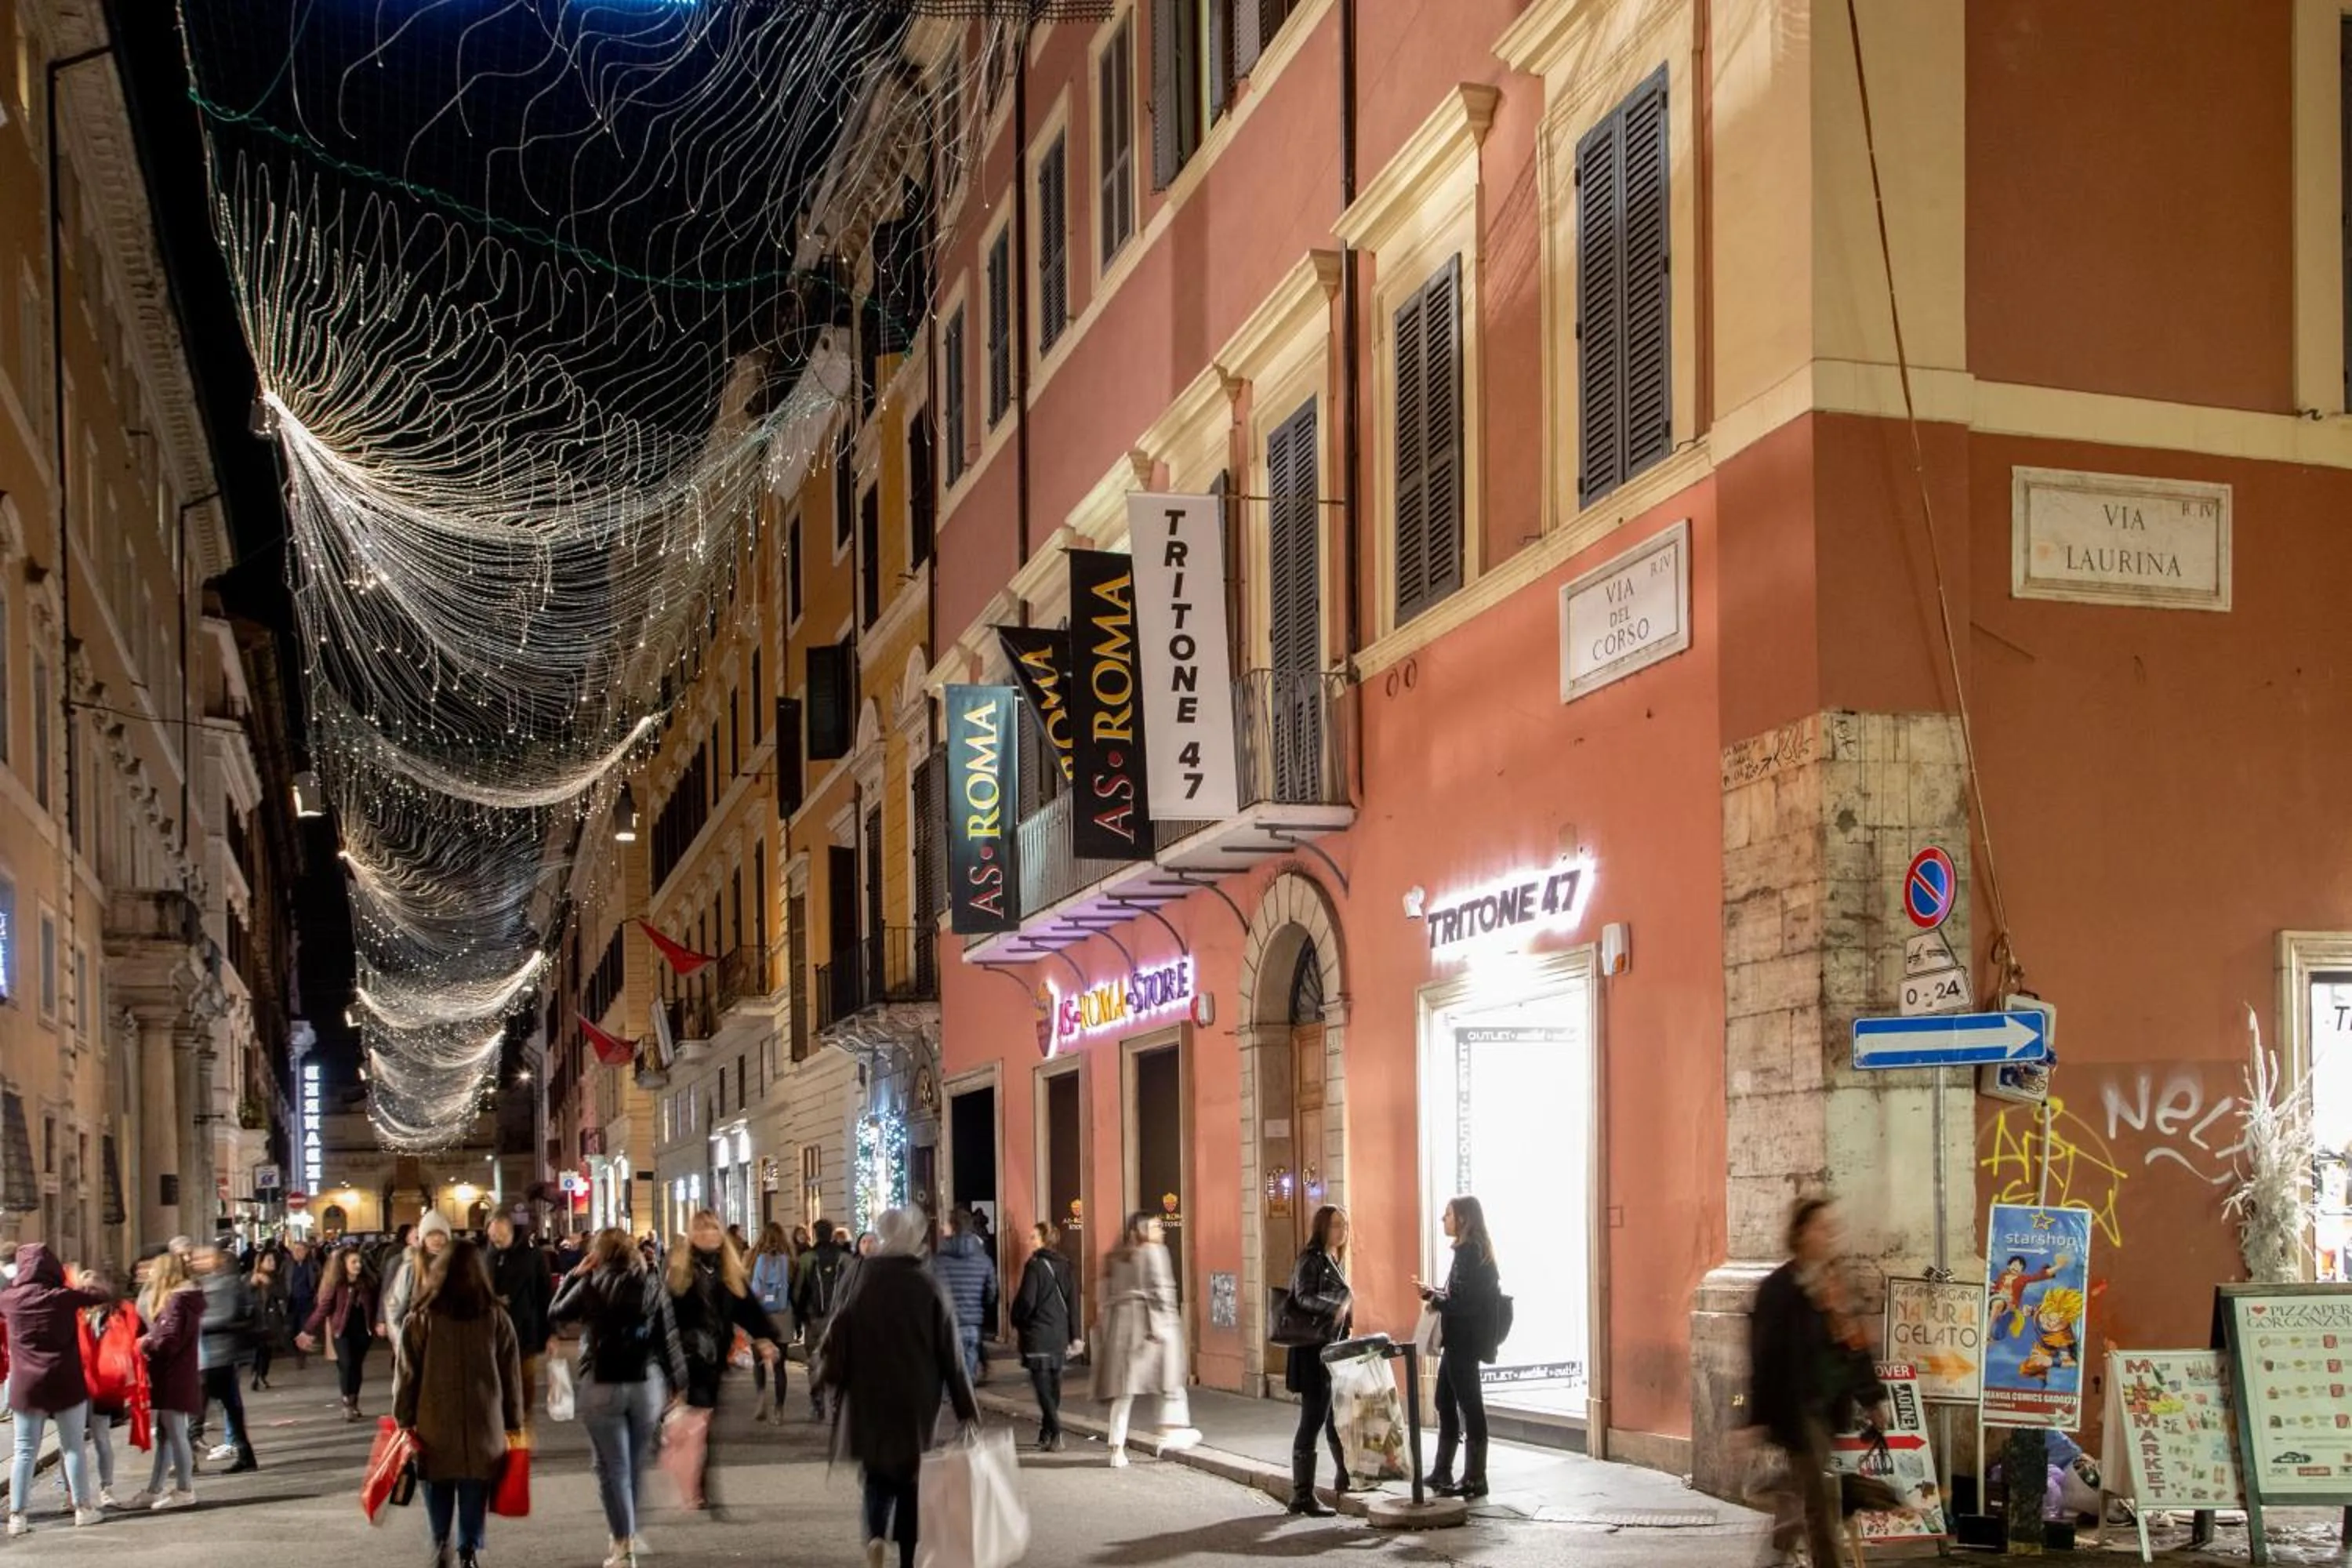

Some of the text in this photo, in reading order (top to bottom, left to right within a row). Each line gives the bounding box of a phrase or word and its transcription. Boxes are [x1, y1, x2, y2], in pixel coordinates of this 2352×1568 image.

[2103, 503, 2146, 531] VIA
[2066, 545, 2182, 577] LAURINA
[1606, 577, 1635, 603] VIA
[1610, 605, 1632, 628] DEL
[1164, 509, 1203, 800] TRITONE 47
[1592, 617, 1650, 661] CORSO
[1091, 570, 1134, 845] AS ROMA
[964, 700, 1004, 919] AS ROMA
[1428, 869, 1581, 949] TRITONE 47
[1131, 961, 1189, 1014] STORE
[1934, 980, 1961, 1000] 24
[2335, 1005, 2352, 1032] T
[2005, 1232, 2077, 1249] starshop
[1894, 1323, 1978, 1348] GELATO
[1894, 1384, 1918, 1430] ENJOY
